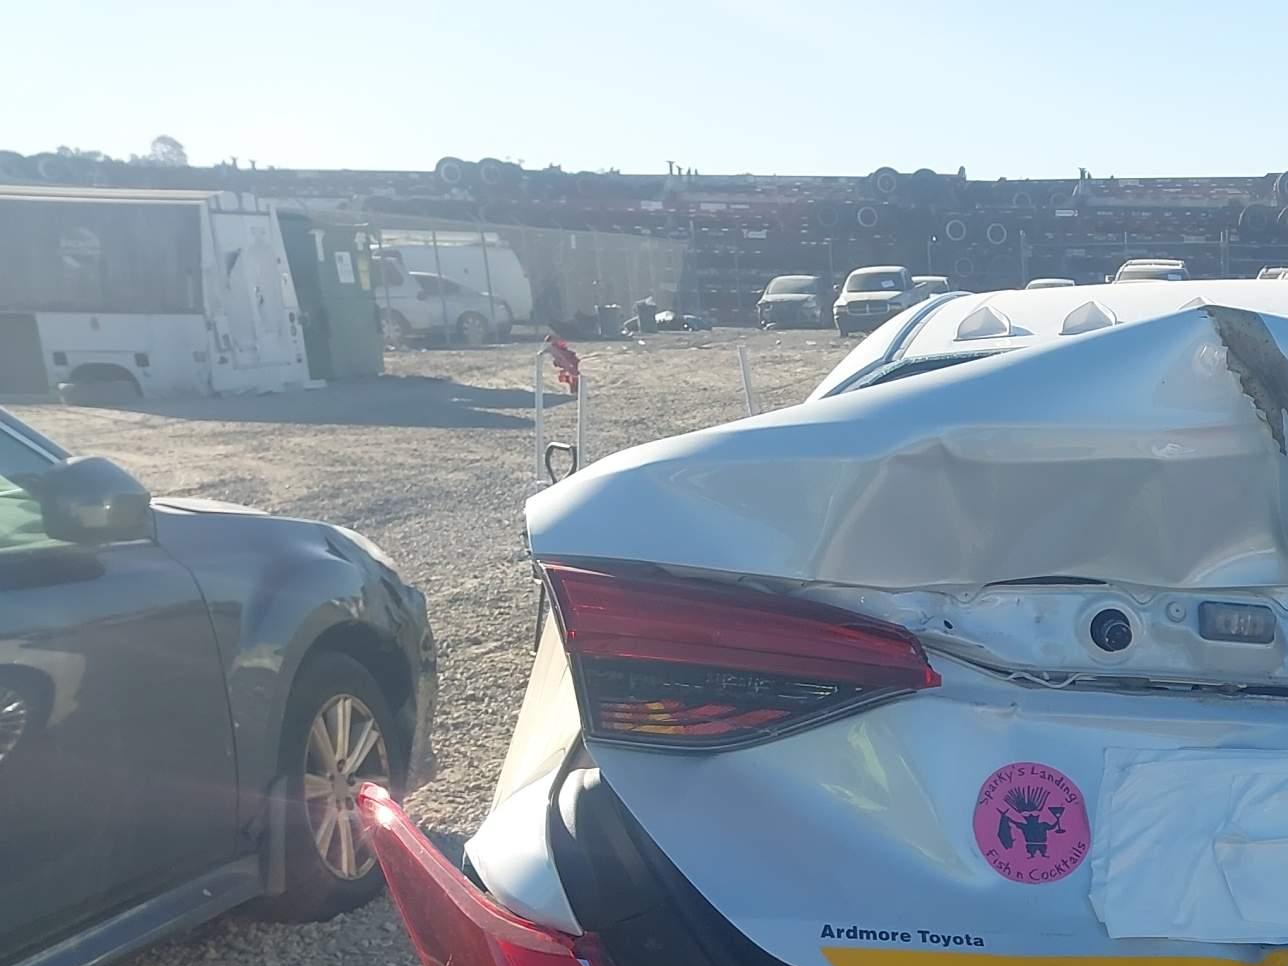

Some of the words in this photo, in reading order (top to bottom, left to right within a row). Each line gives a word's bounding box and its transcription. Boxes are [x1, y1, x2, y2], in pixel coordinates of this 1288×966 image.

[1030, 766, 1078, 804] Landing
[986, 848, 1012, 877] Fish
[820, 923, 912, 943] Ardmore
[917, 929, 986, 948] Toyota
